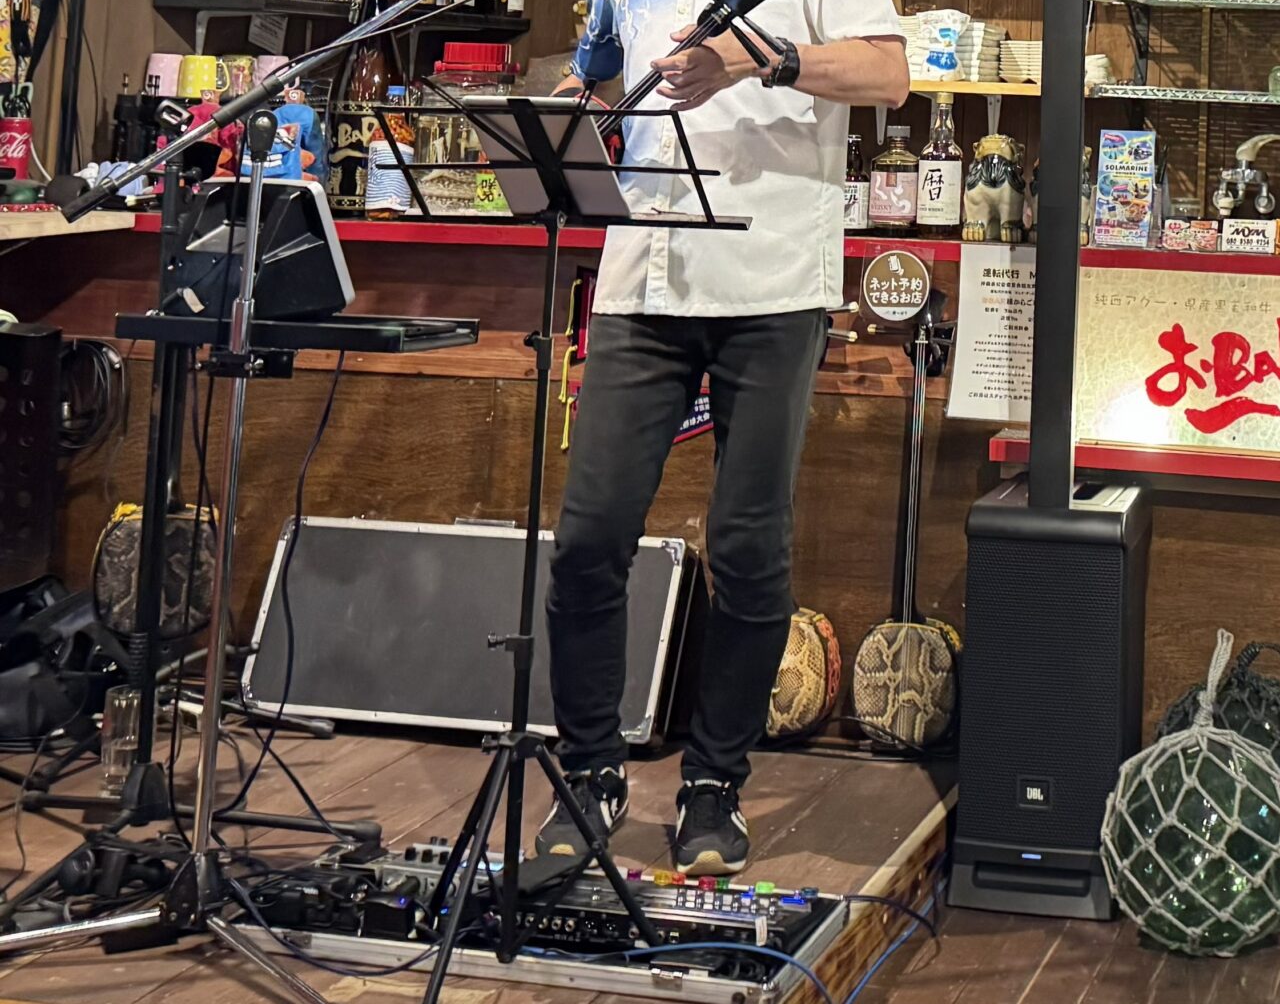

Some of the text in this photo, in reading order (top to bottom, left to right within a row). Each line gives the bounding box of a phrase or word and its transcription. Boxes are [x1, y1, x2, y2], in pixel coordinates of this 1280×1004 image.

[1105, 164, 1148, 173] SOLMARINE
[982, 267, 1020, 280] 運転代行
[869, 277, 923, 292] ネット予約
[869, 291, 923, 304] できるお店
[1026, 786, 1044, 801] JBL
